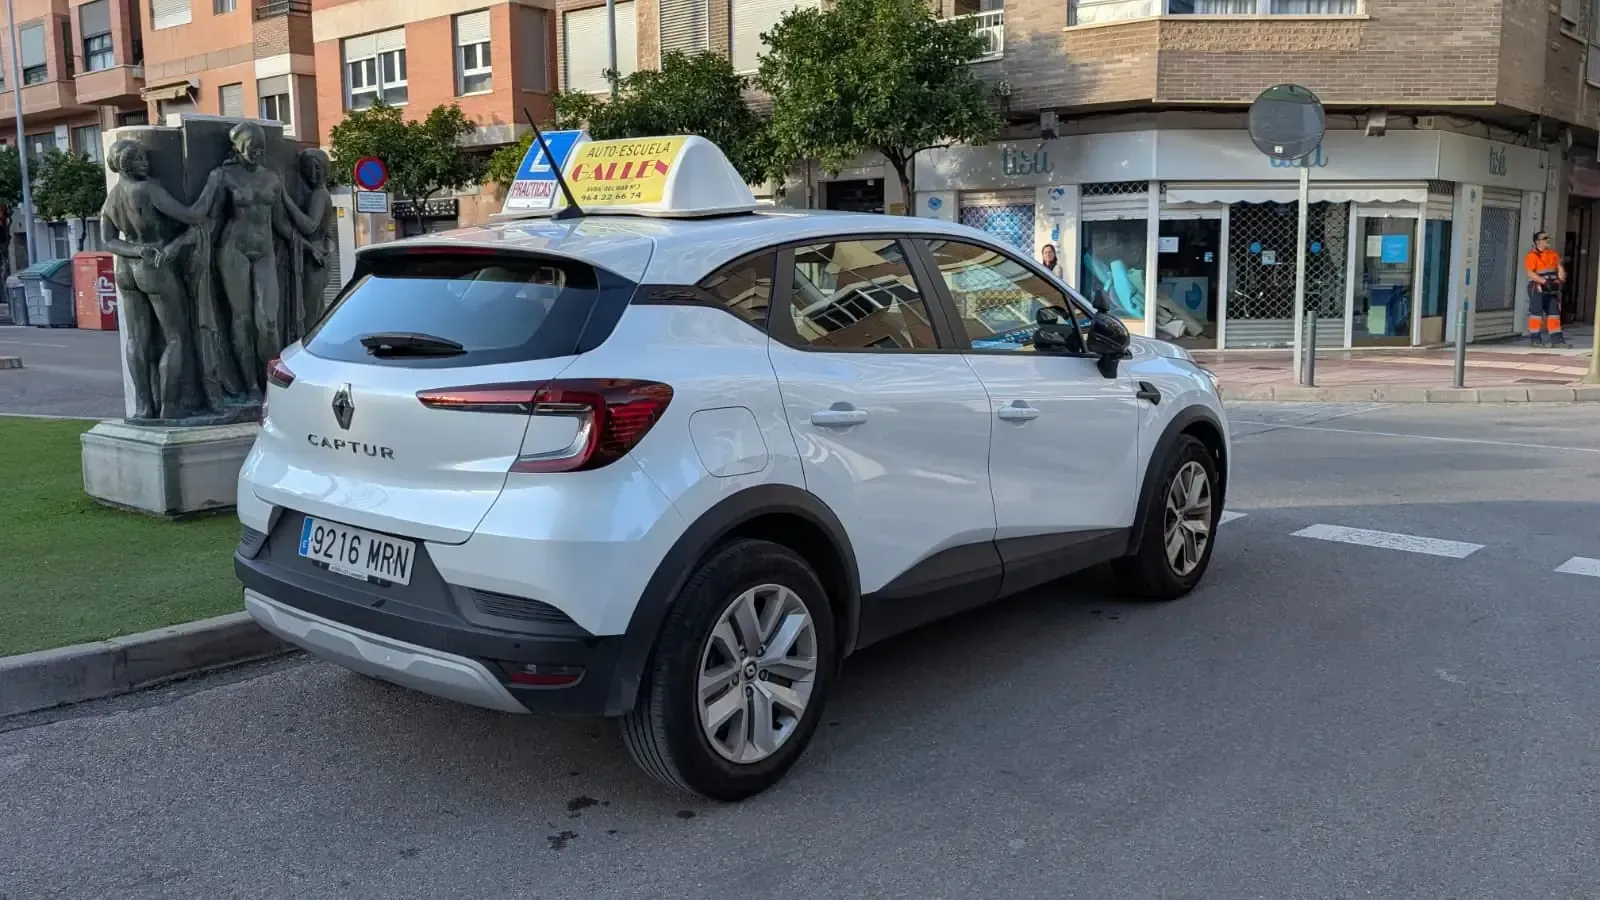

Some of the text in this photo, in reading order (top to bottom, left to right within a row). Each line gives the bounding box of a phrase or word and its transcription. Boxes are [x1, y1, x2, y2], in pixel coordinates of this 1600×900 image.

[529, 138, 552, 172] L
[586, 142, 671, 158] AUTO-ESCUELA
[1002, 142, 1054, 176] tisú
[572, 159, 672, 182] GALLEN
[581, 193, 598, 201] 964
[601, 193, 613, 201] 22
[630, 191, 641, 199] 74
[307, 433, 395, 460] CAPTUR
[312, 525, 361, 565] 9216
[366, 538, 409, 578] MRN
